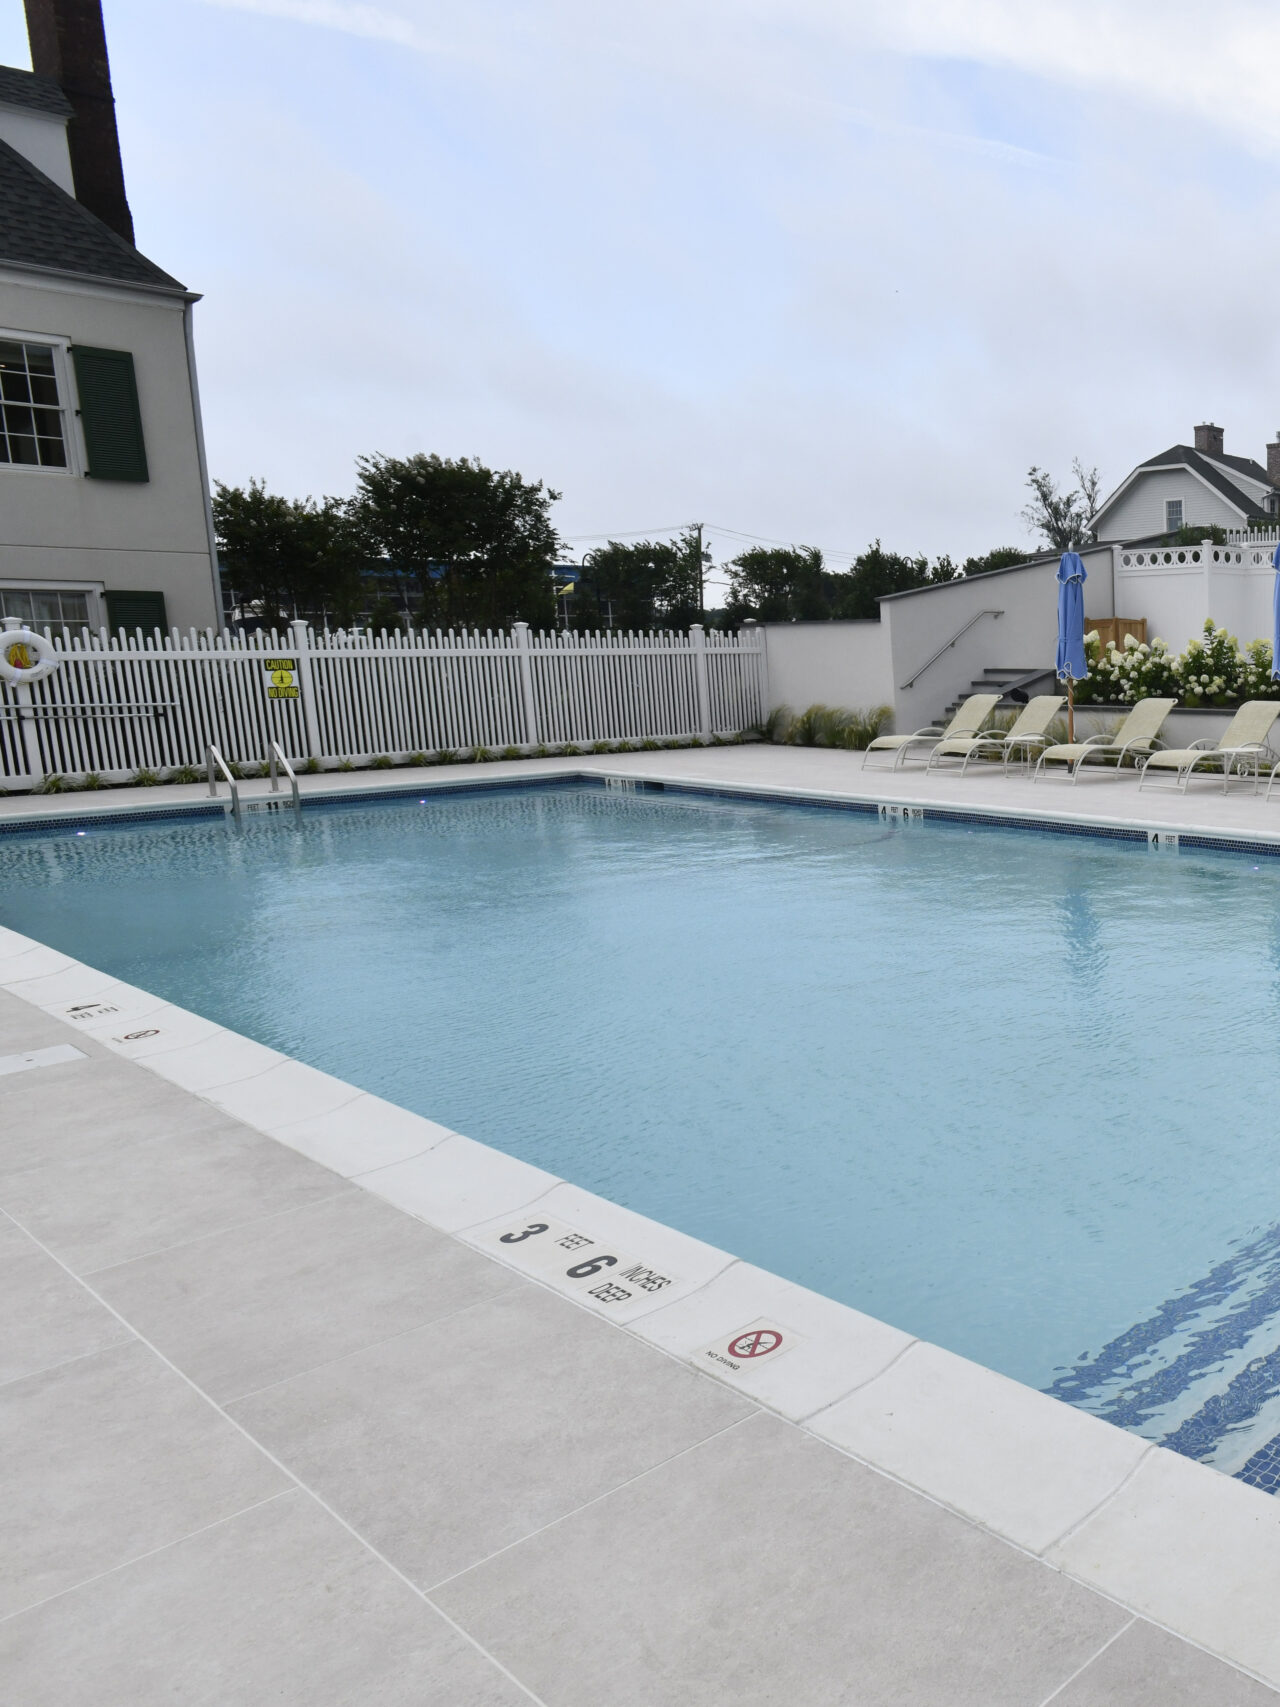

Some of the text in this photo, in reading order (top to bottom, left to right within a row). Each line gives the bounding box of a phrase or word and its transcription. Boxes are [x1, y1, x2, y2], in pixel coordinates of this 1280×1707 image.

[265, 659, 293, 670] CAUTION
[268, 687, 298, 697] NO DIVING
[499, 1223, 673, 1293] 3 FEET 6 INCHES
[587, 1282, 632, 1304] DEEP
[705, 1350, 740, 1371] NO DIVING
